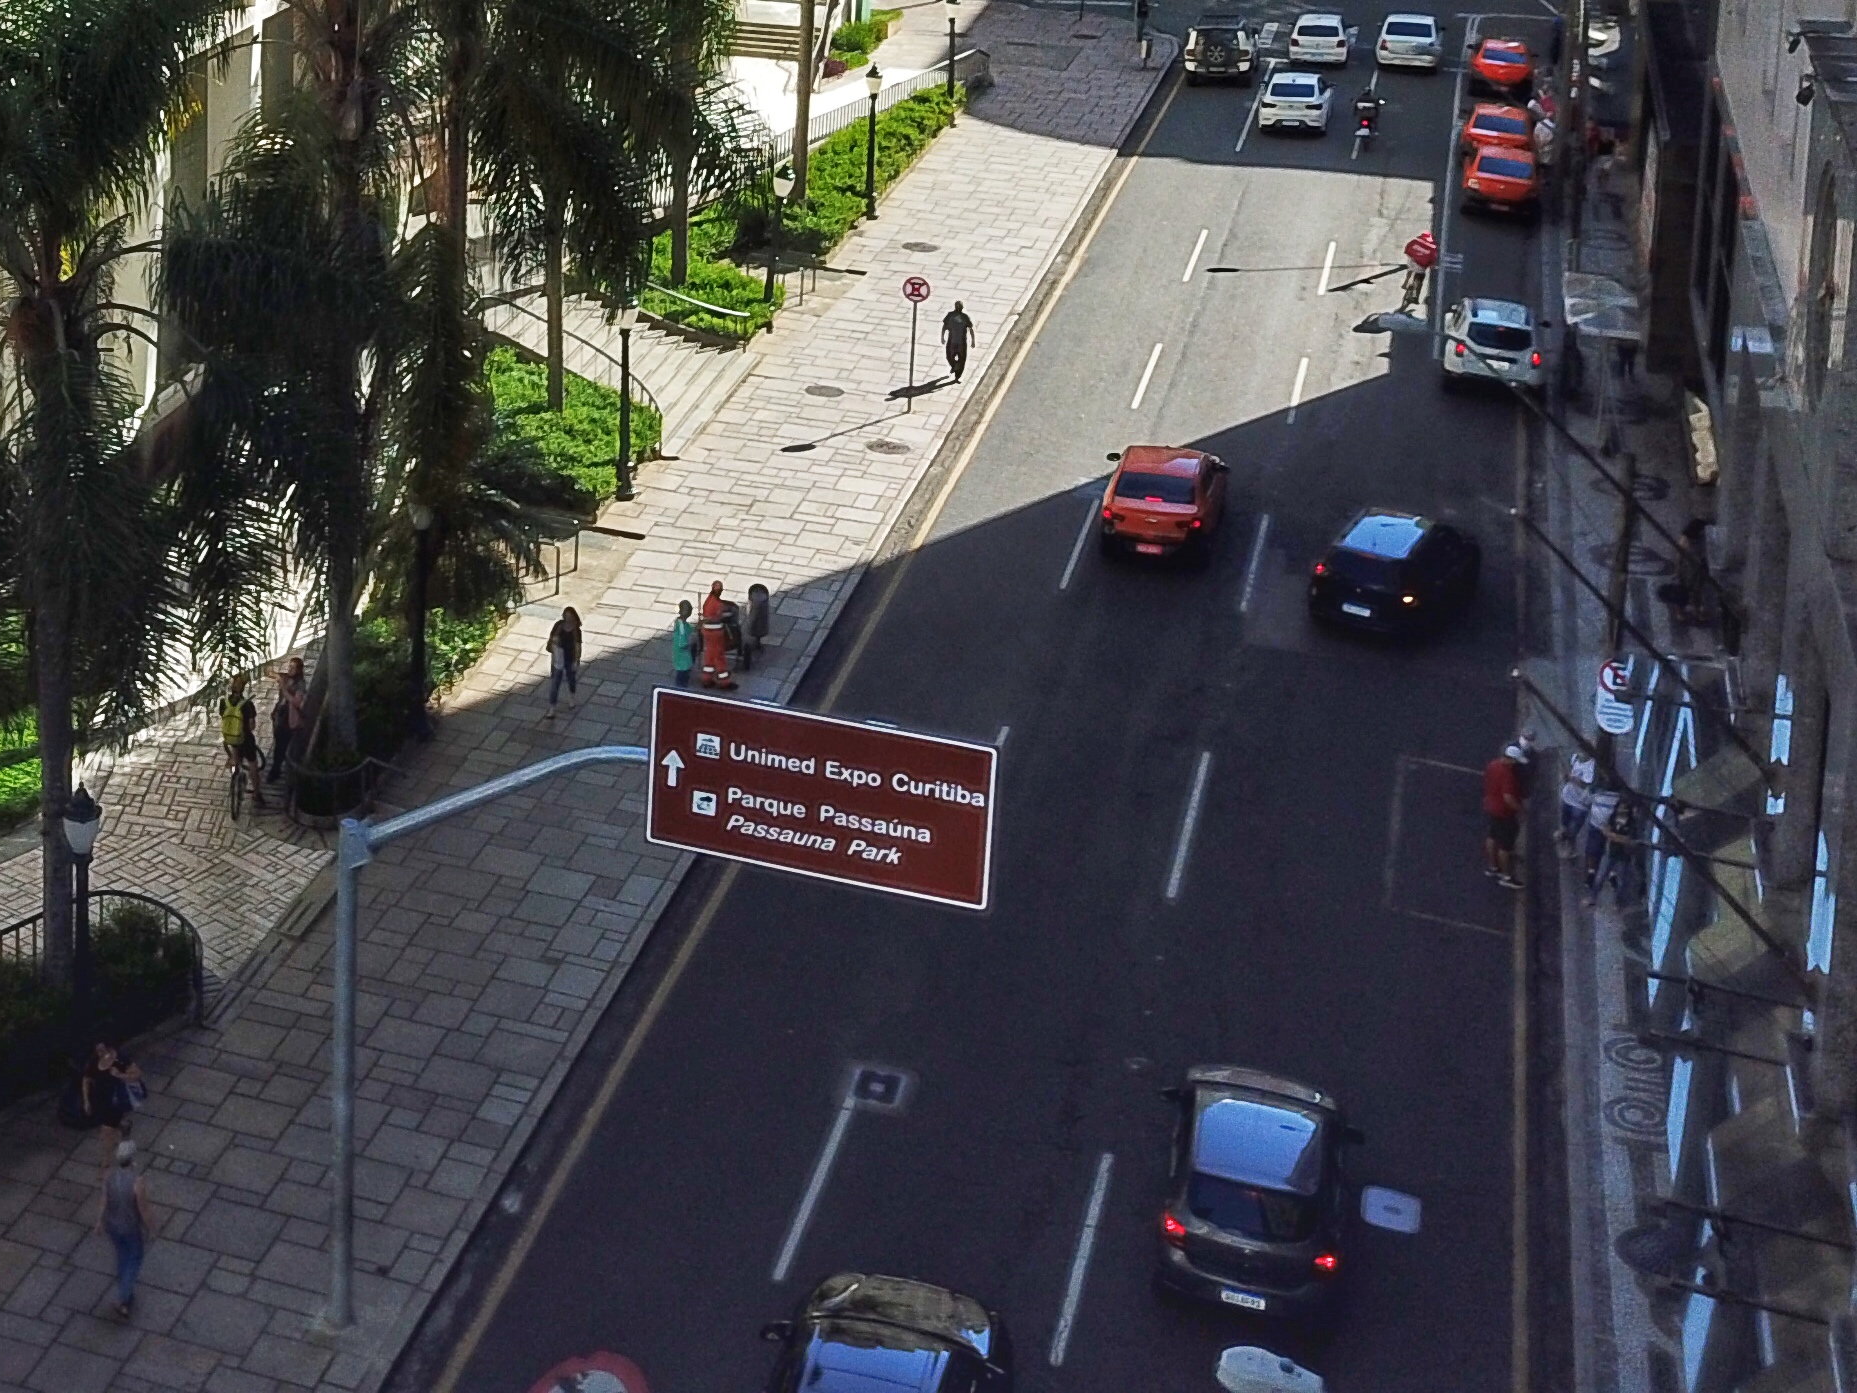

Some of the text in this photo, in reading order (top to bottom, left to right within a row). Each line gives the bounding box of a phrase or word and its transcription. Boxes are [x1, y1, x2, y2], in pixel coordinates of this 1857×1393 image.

[730, 742, 986, 808] Unimed Expo Curitiba
[725, 816, 902, 866] Passauna Park
[726, 788, 931, 843] Parque Passaúna
